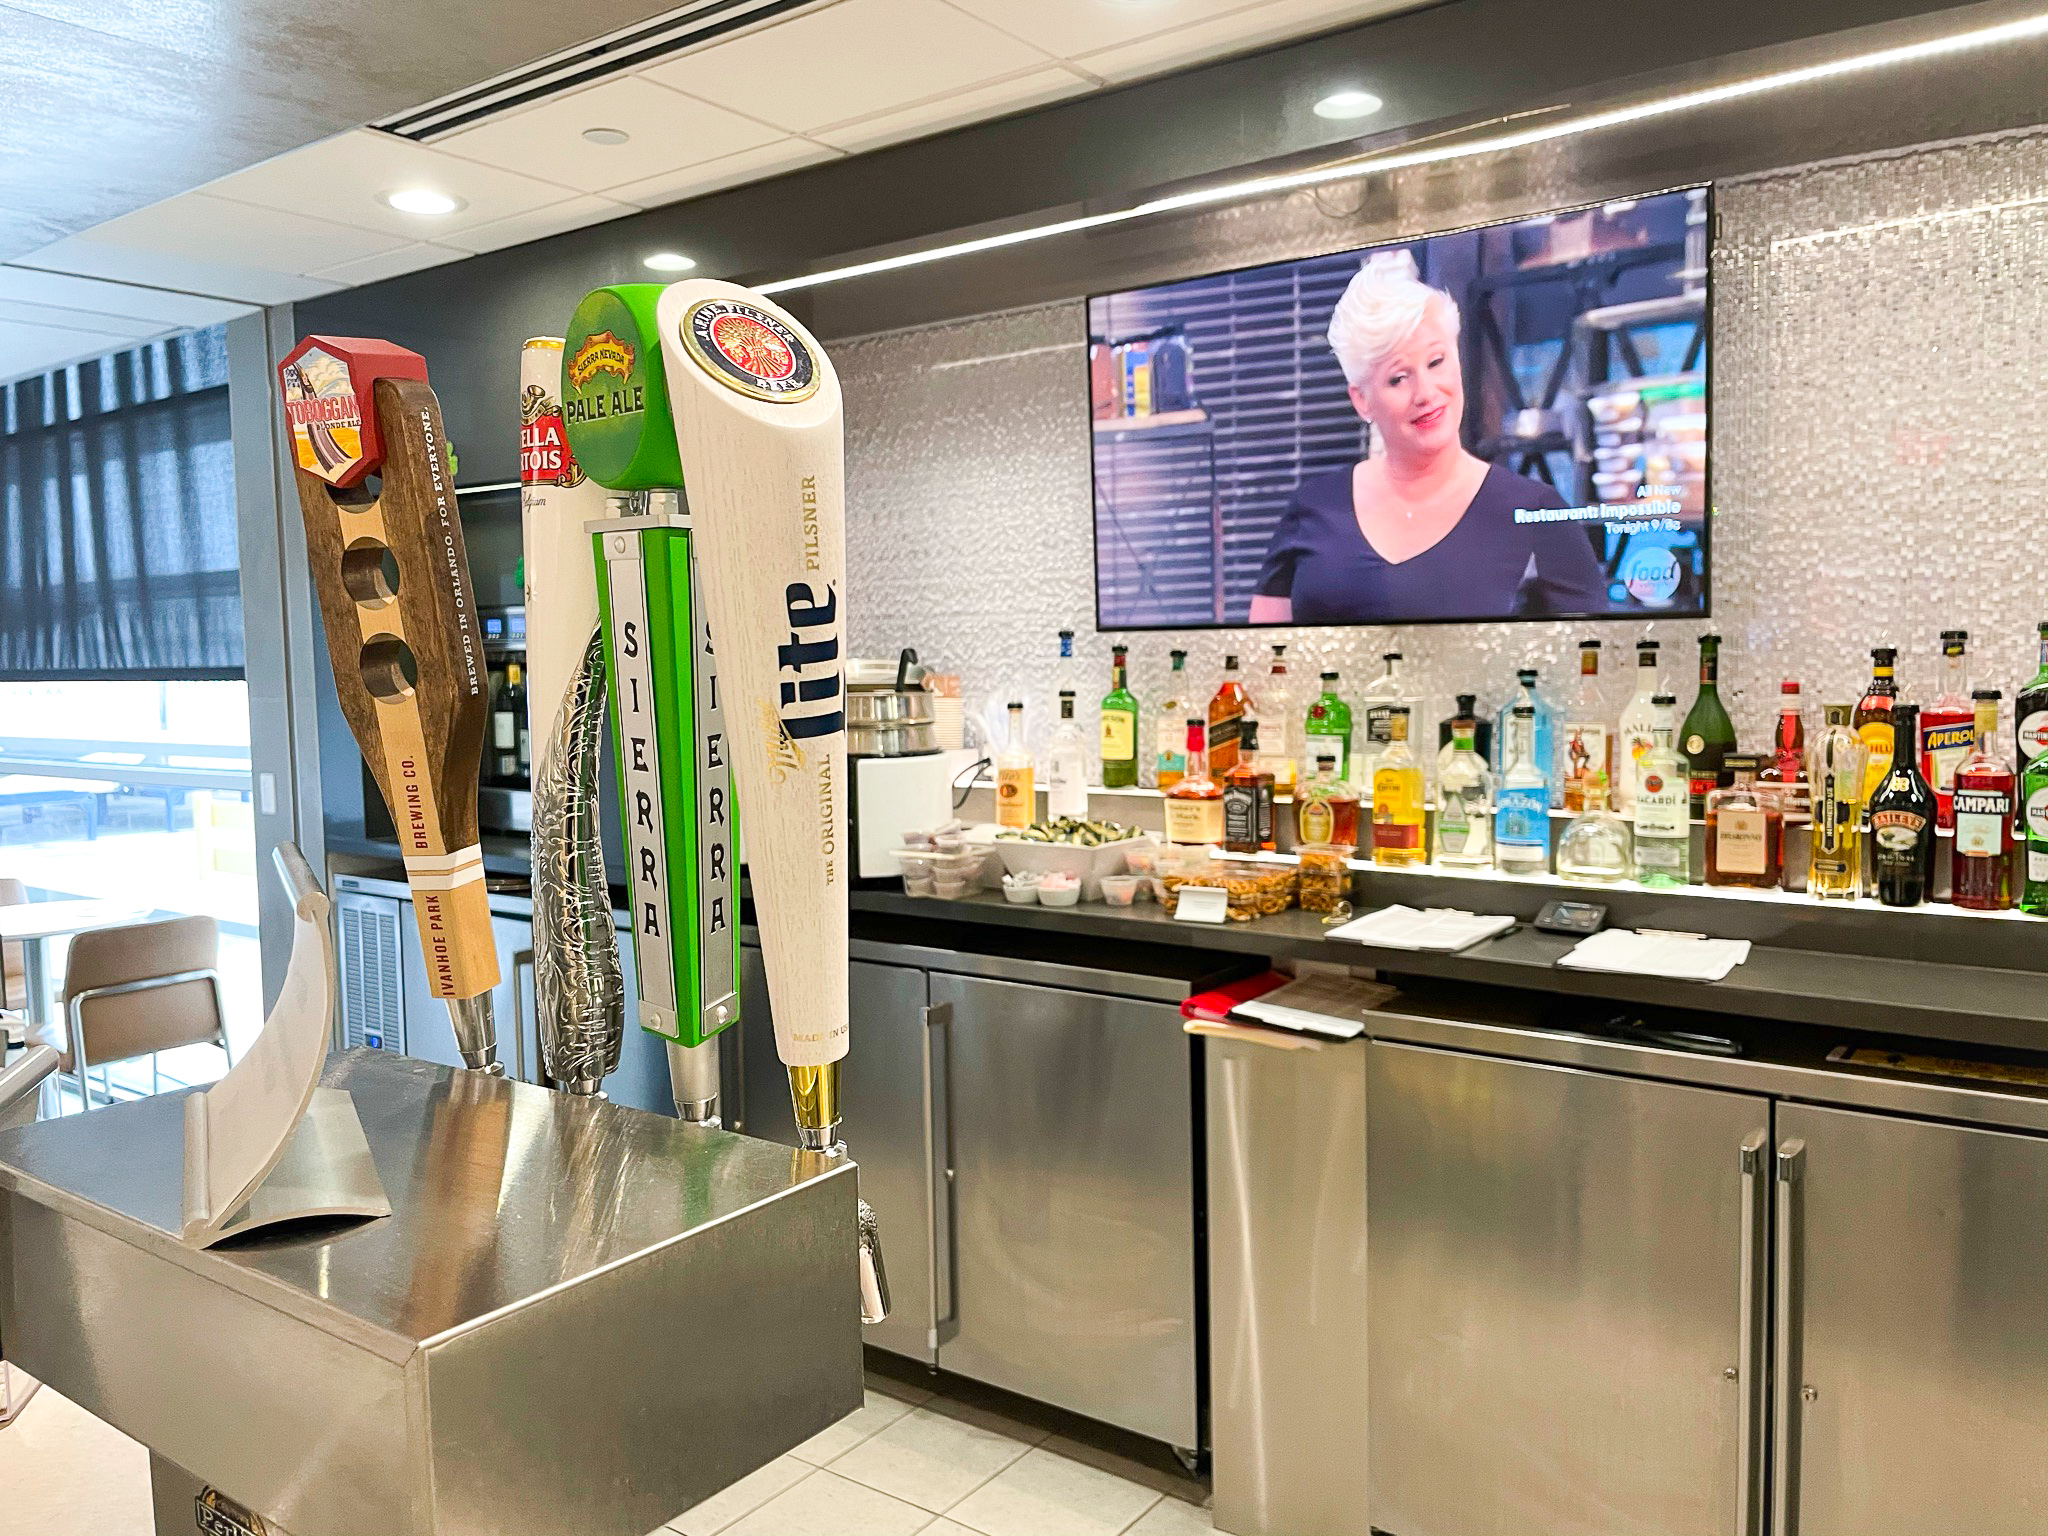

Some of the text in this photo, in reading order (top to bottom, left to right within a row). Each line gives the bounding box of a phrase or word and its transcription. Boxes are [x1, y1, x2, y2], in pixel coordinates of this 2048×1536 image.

[726, 304, 796, 344] PILSNER
[577, 348, 625, 376] SIERRA NEVADA
[755, 377, 803, 392] BEER
[286, 395, 361, 425] TOBOGGAN
[566, 386, 645, 426] PALE ALE
[316, 419, 361, 431] BLONDE ALE
[521, 427, 561, 448] ELLA
[521, 449, 562, 470] TOIS
[1636, 484, 1682, 498] All New
[801, 474, 820, 571] PILSNER
[1600, 499, 1682, 521] Impossible
[1604, 520, 1649, 536] Tonight
[420, 406, 478, 696] BREWED IN ORLANDO. FOR EVERYONE.
[1627, 559, 1680, 589] food
[1926, 729, 1975, 749] APEROL
[623, 620, 662, 939] SIERRA
[704, 619, 727, 935] SIERRA
[1953, 795, 2009, 813] CAMPARI
[812, 753, 834, 886] THE ORIGINAL
[401, 755, 456, 996] IVANHOE PARK BREWING CO.
